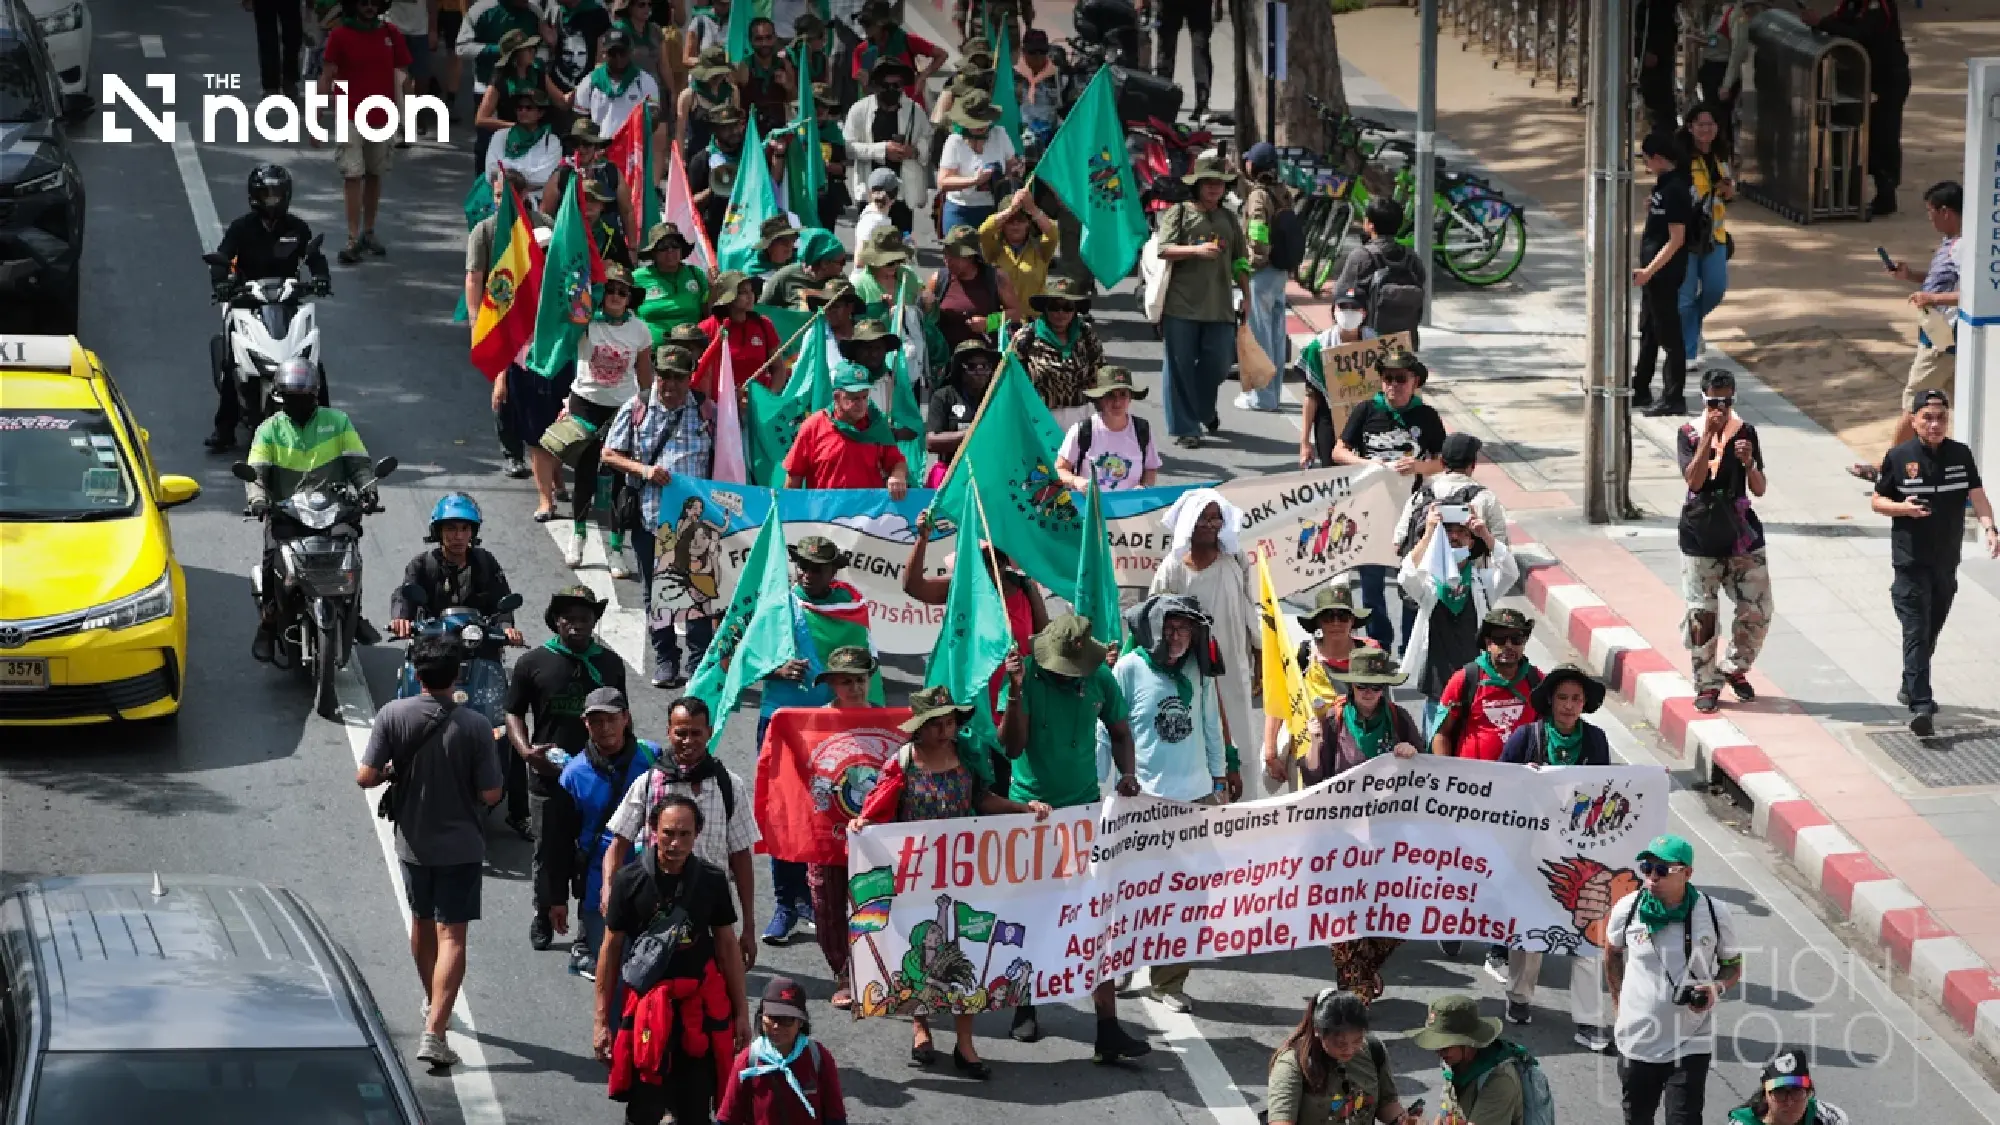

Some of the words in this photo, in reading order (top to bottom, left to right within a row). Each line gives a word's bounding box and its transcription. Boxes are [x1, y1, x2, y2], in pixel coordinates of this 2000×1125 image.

[1280, 476, 1352, 510] NOW!!
[1362, 769, 1439, 795] People's
[1446, 775, 1492, 798] Food
[1179, 819, 1209, 842] and
[1214, 809, 1280, 838] against
[1286, 795, 1419, 823] Transnational
[1425, 796, 1550, 831] Corporations
[893, 818, 1095, 894] #16OCT26
[1116, 871, 1164, 904] Food
[1169, 854, 1303, 893] Sovereignty
[1310, 848, 1338, 873] of
[1342, 845, 1385, 868] Our
[1392, 840, 1493, 879] Peoples,
[1035, 962, 1096, 998] Let's
[1142, 932, 1187, 961] the
[1197, 916, 1298, 956] People,
[1309, 910, 1358, 942] Not
[1365, 902, 1411, 935] the
[1421, 904, 1517, 943] Debts!
[1065, 913, 1129, 961] Aganst
[1132, 902, 1177, 932] IMF
[1180, 897, 1227, 923] and
[1233, 884, 1299, 918] World
[1307, 878, 1369, 907] Bank
[1374, 875, 1478, 903] policies!
